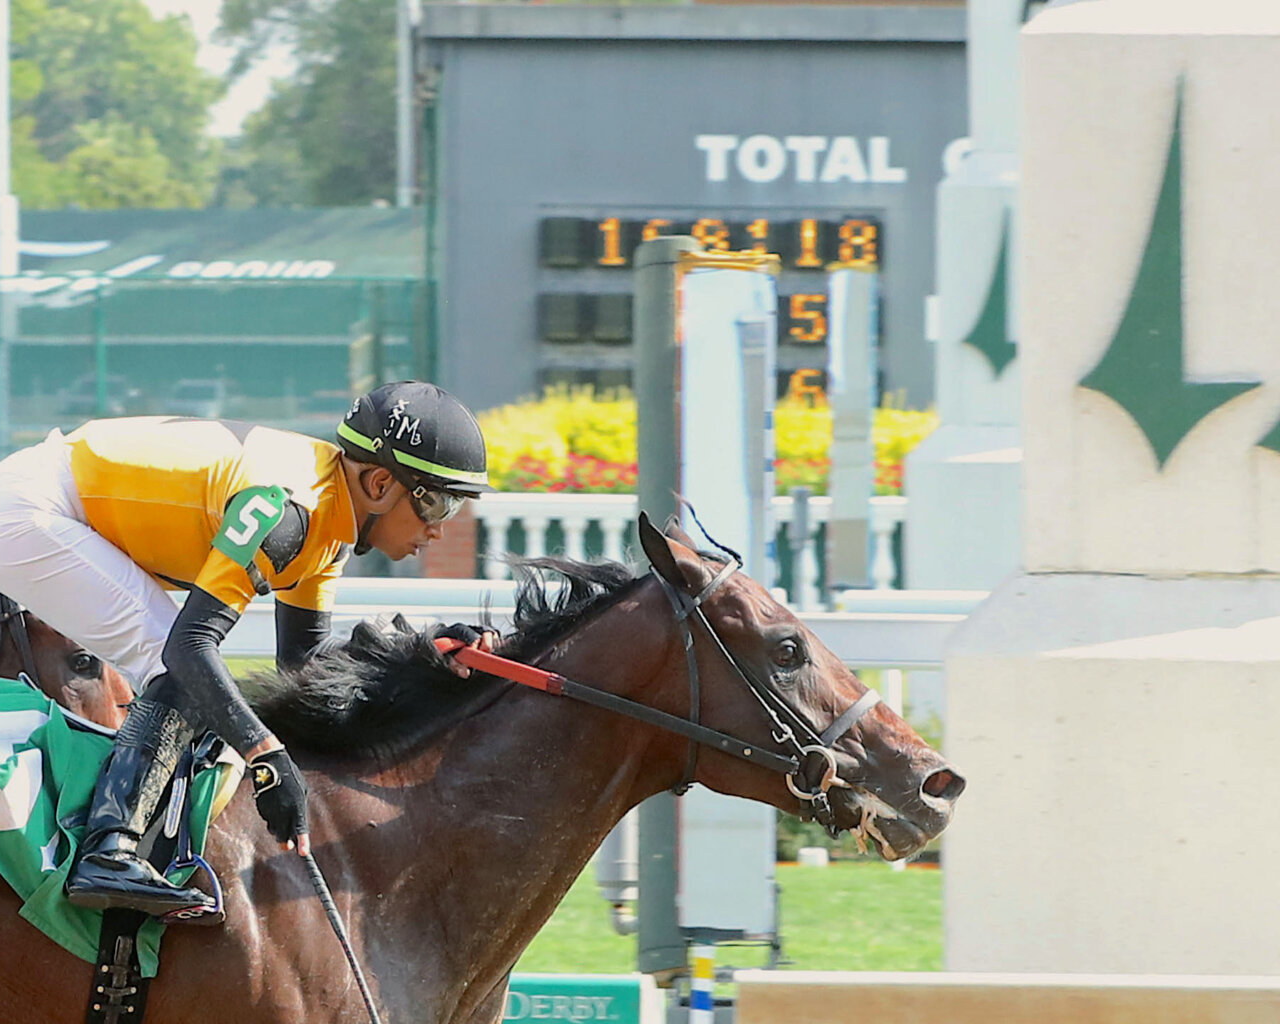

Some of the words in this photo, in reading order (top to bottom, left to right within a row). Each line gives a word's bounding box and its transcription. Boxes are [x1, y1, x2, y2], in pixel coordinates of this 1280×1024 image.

[695, 134, 907, 183] TOTAL
[789, 294, 826, 341] 5
[224, 494, 280, 546] 5
[504, 991, 614, 1024] DERBY
